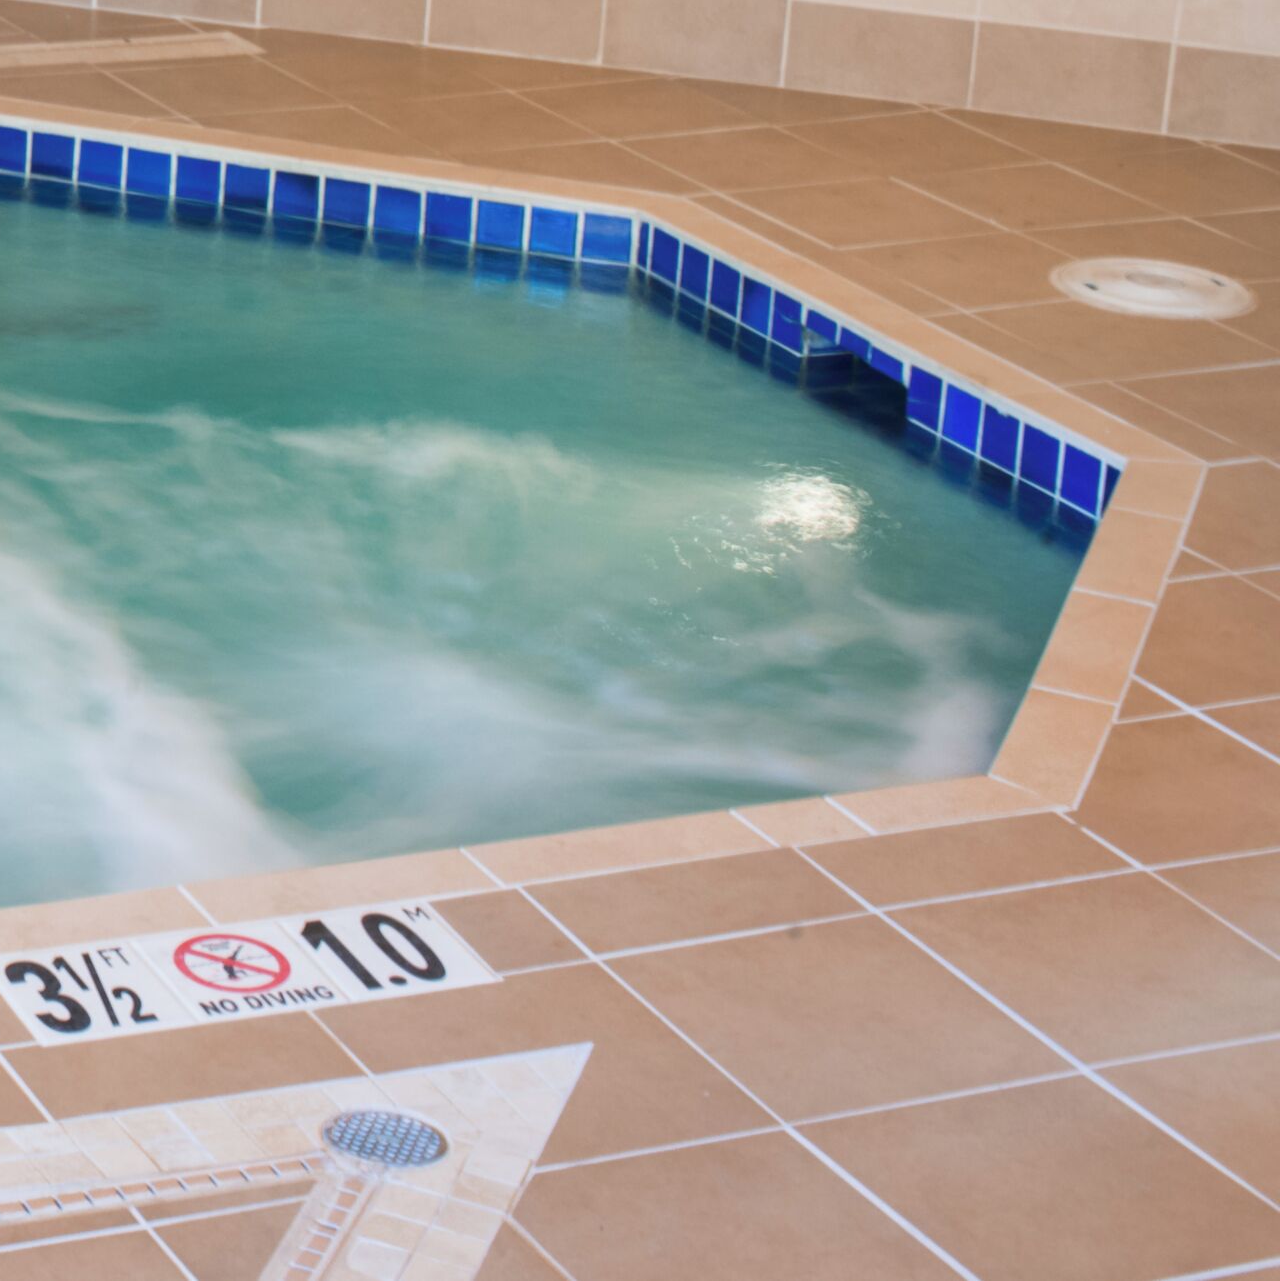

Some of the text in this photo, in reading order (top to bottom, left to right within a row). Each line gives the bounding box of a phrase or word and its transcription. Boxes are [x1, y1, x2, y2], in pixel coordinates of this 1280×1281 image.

[98, 946, 130, 968] FT
[300, 907, 447, 990] 1.0 M
[198, 985, 335, 1016] NO DIVING
